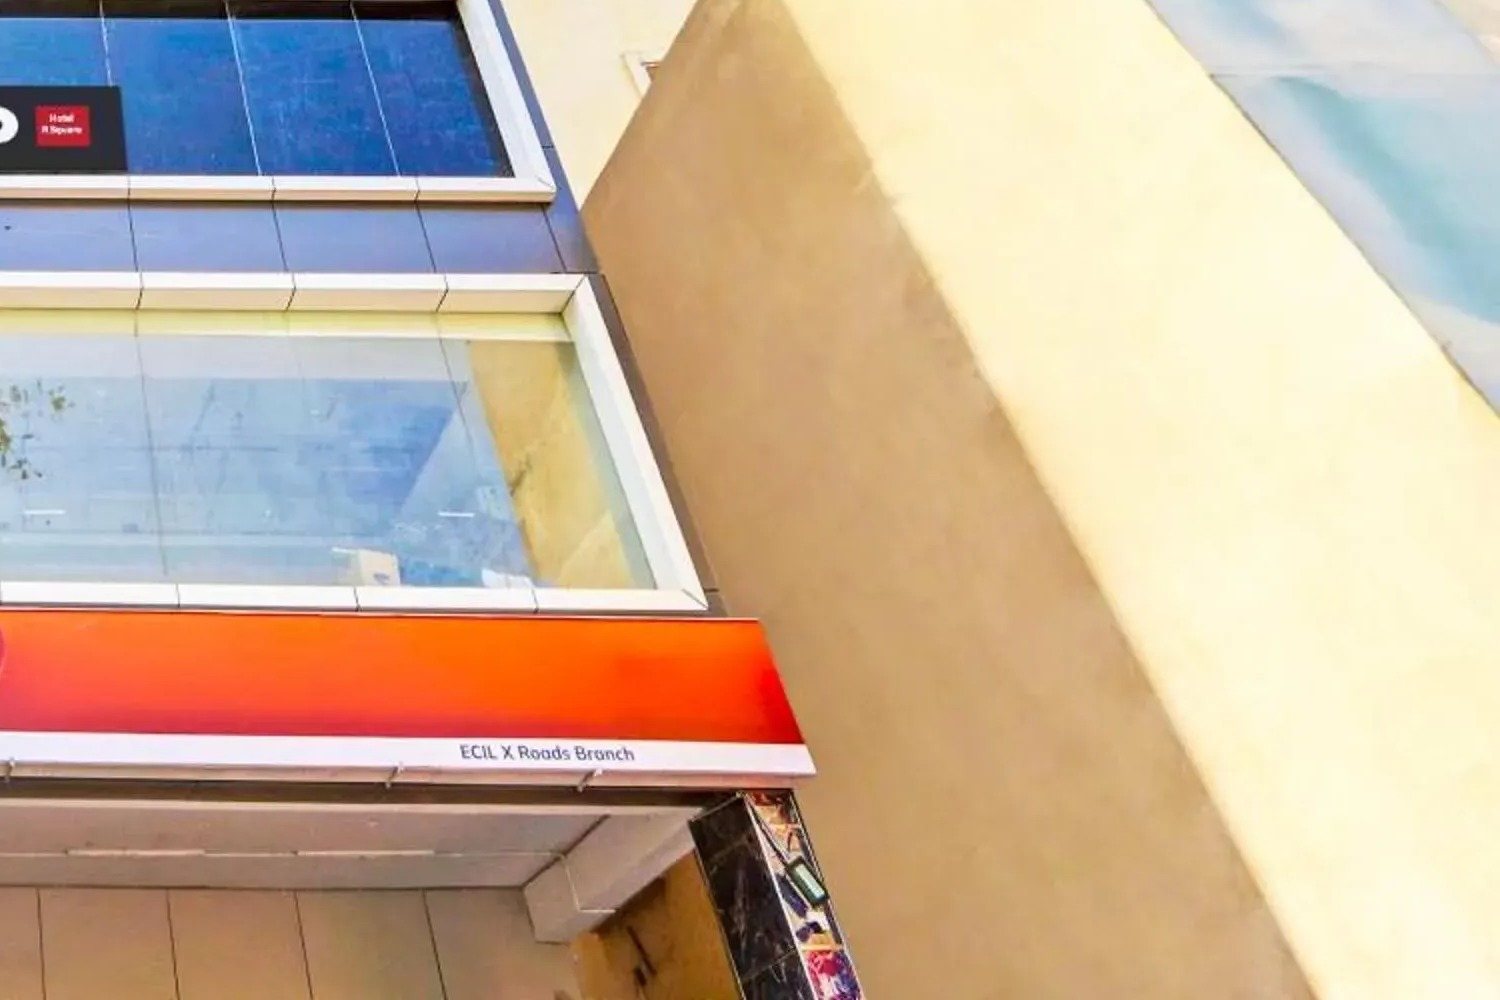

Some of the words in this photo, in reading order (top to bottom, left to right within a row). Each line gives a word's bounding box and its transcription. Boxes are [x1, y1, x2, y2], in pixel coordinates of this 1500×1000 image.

[459, 744, 497, 760] ECIL
[501, 745, 515, 760] X
[517, 745, 571, 761] Roads
[574, 745, 636, 762] Branch
